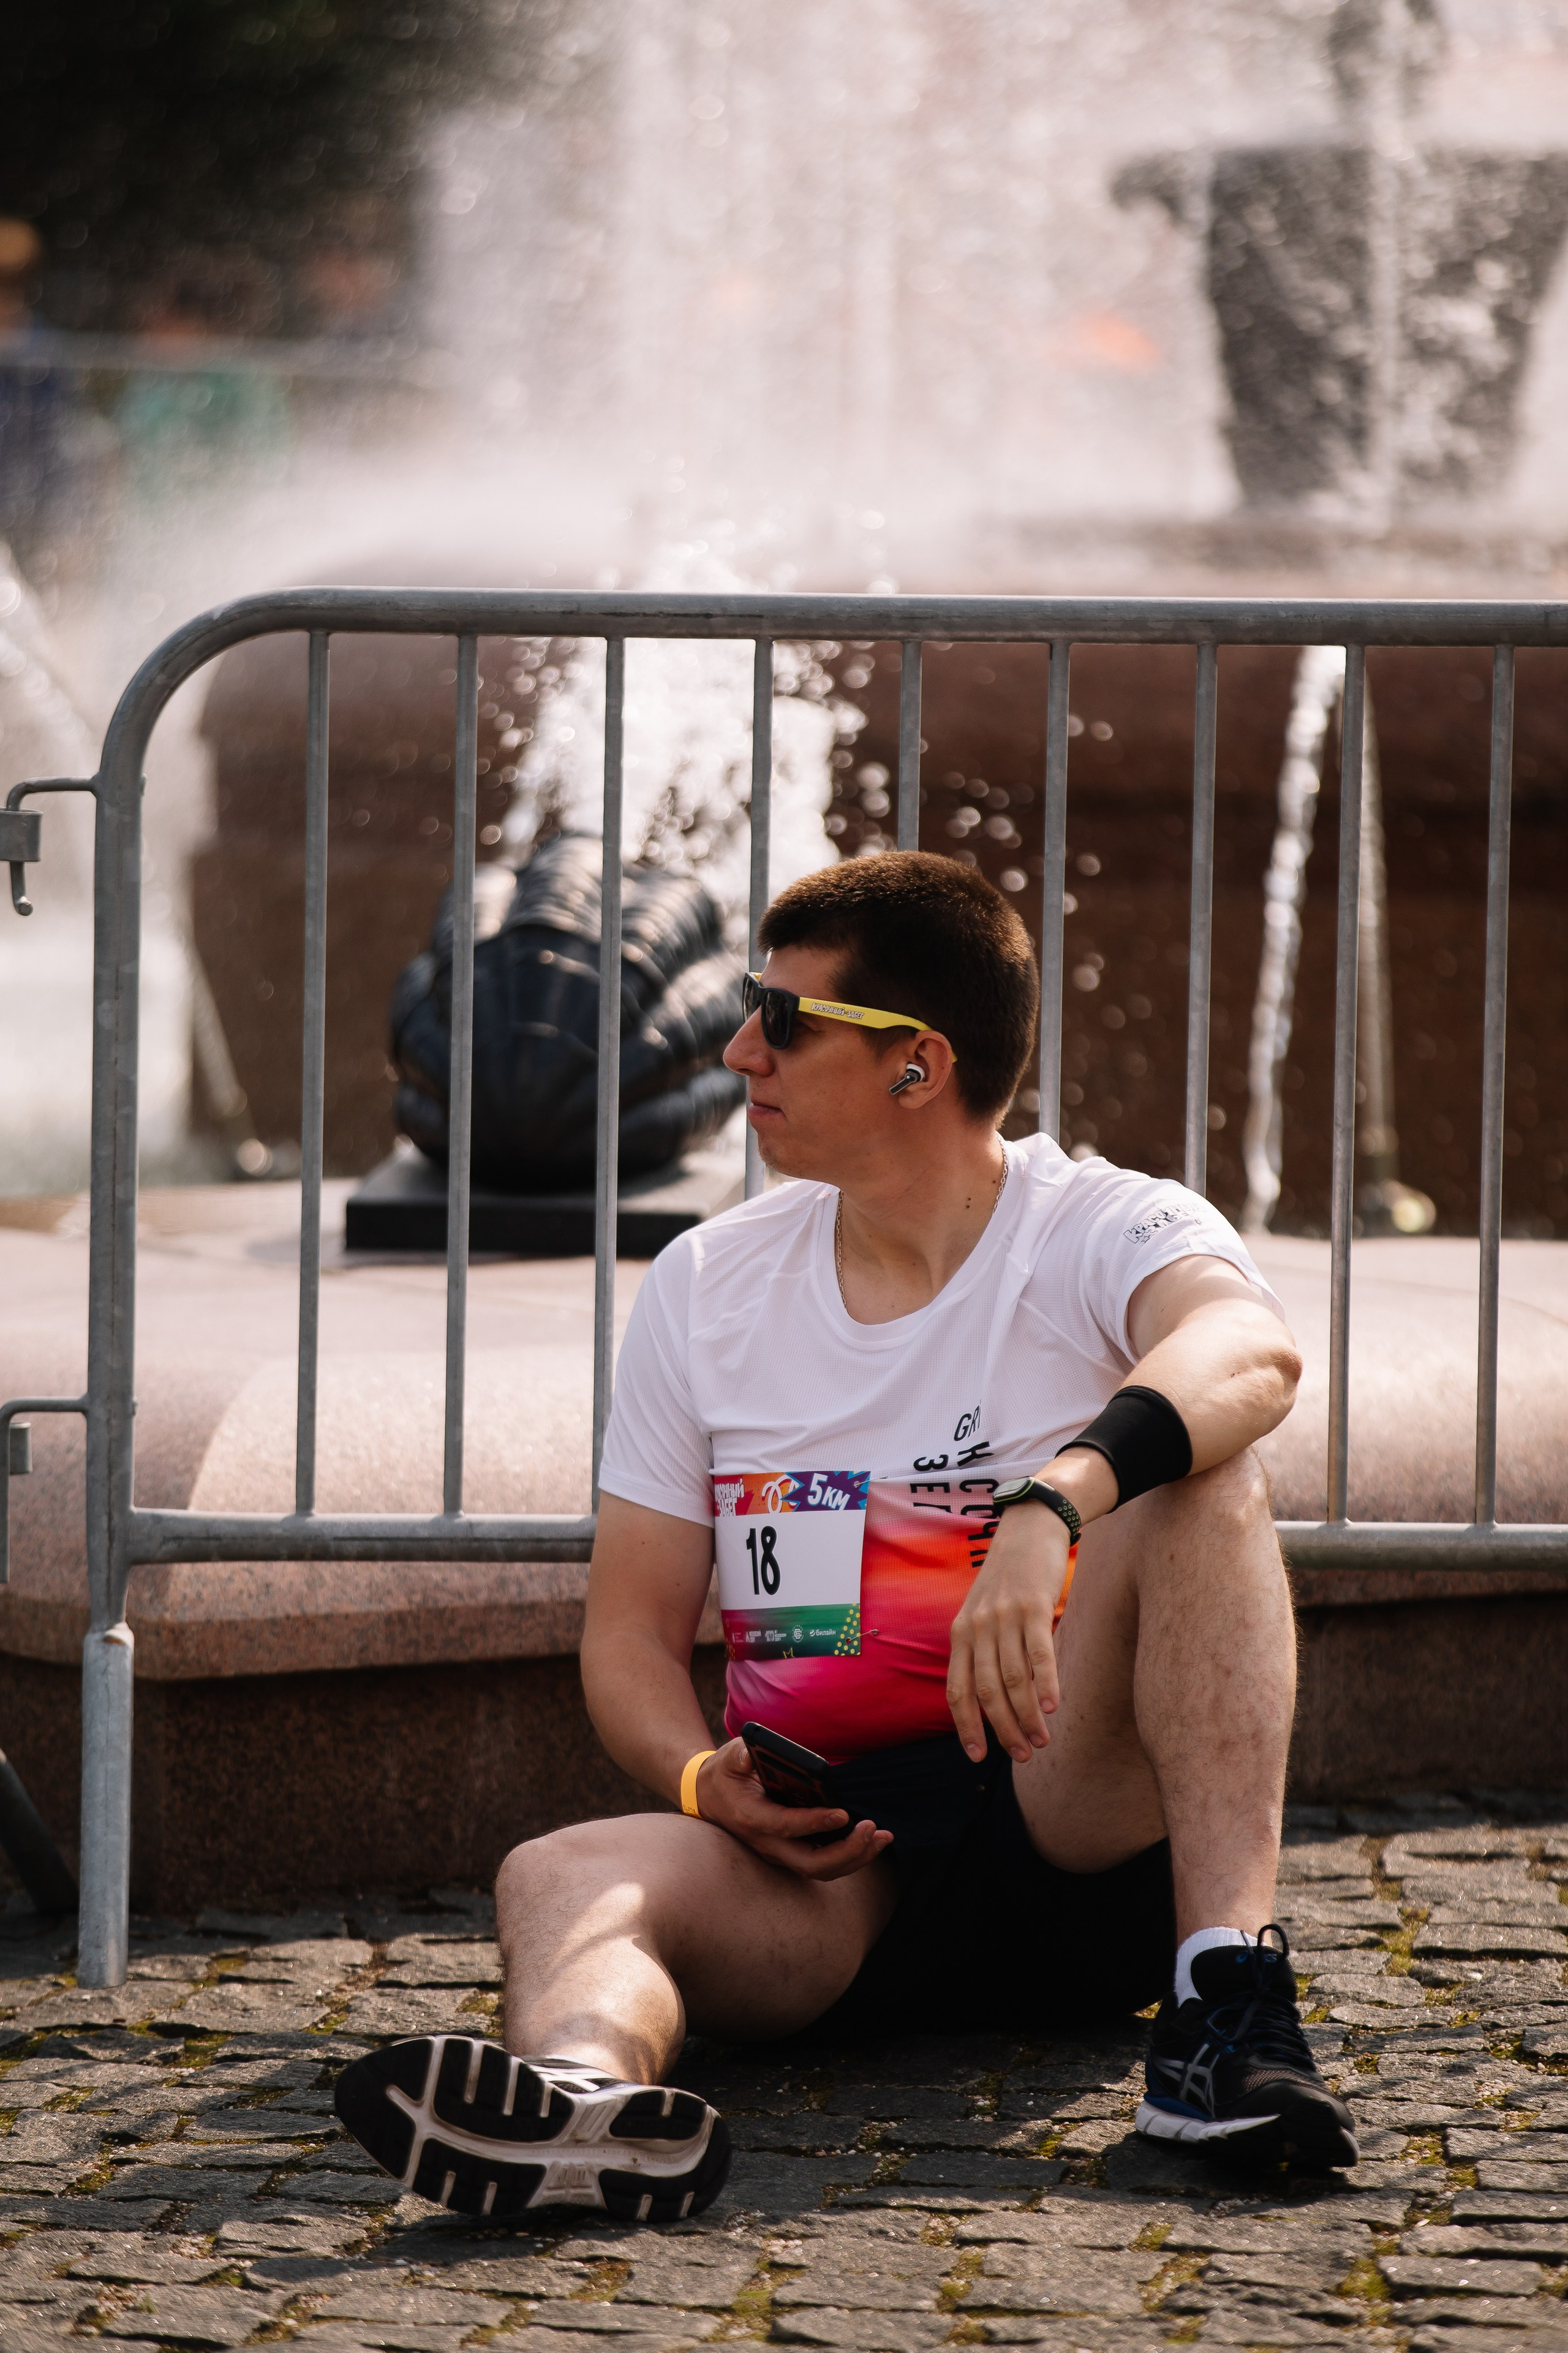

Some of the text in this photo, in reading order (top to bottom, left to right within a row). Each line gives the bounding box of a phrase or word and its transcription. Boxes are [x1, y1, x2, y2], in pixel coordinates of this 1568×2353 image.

[811, 1002, 864, 1020] КРАСОЧНЫЙ ЗАБЕГ
[745, 1525, 781, 1596] 18
